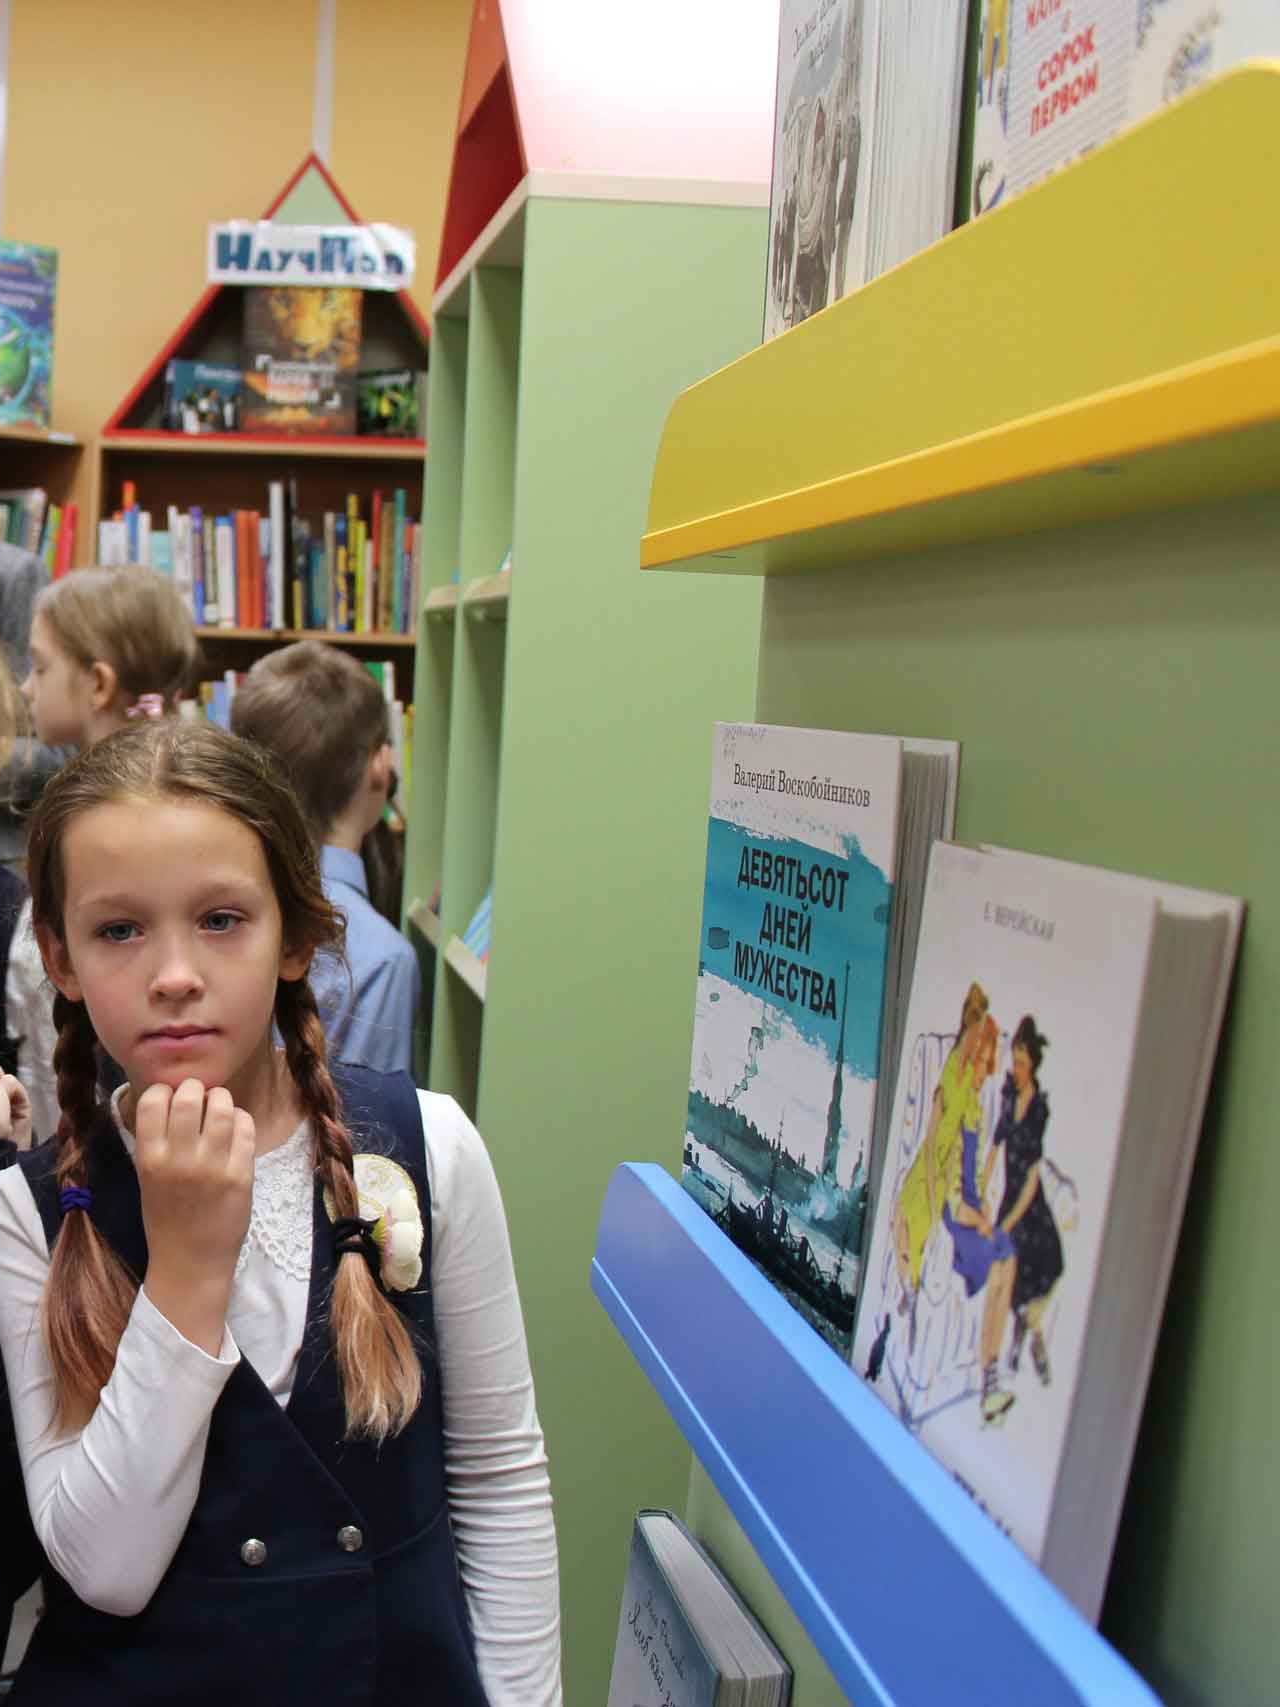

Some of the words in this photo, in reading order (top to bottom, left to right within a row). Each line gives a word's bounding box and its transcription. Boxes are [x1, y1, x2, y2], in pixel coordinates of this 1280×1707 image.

[1038, 22, 1095, 92] СОРОК
[1029, 58, 1099, 137] ПЕРВОМ
[733, 762, 776, 794] Валерий
[778, 769, 871, 808] Воскобойников
[737, 845, 850, 913] ДЕВЯТЬСОТ
[759, 901, 813, 956] ДНЕЙ
[734, 940, 837, 1021] МУЖЕСТВА
